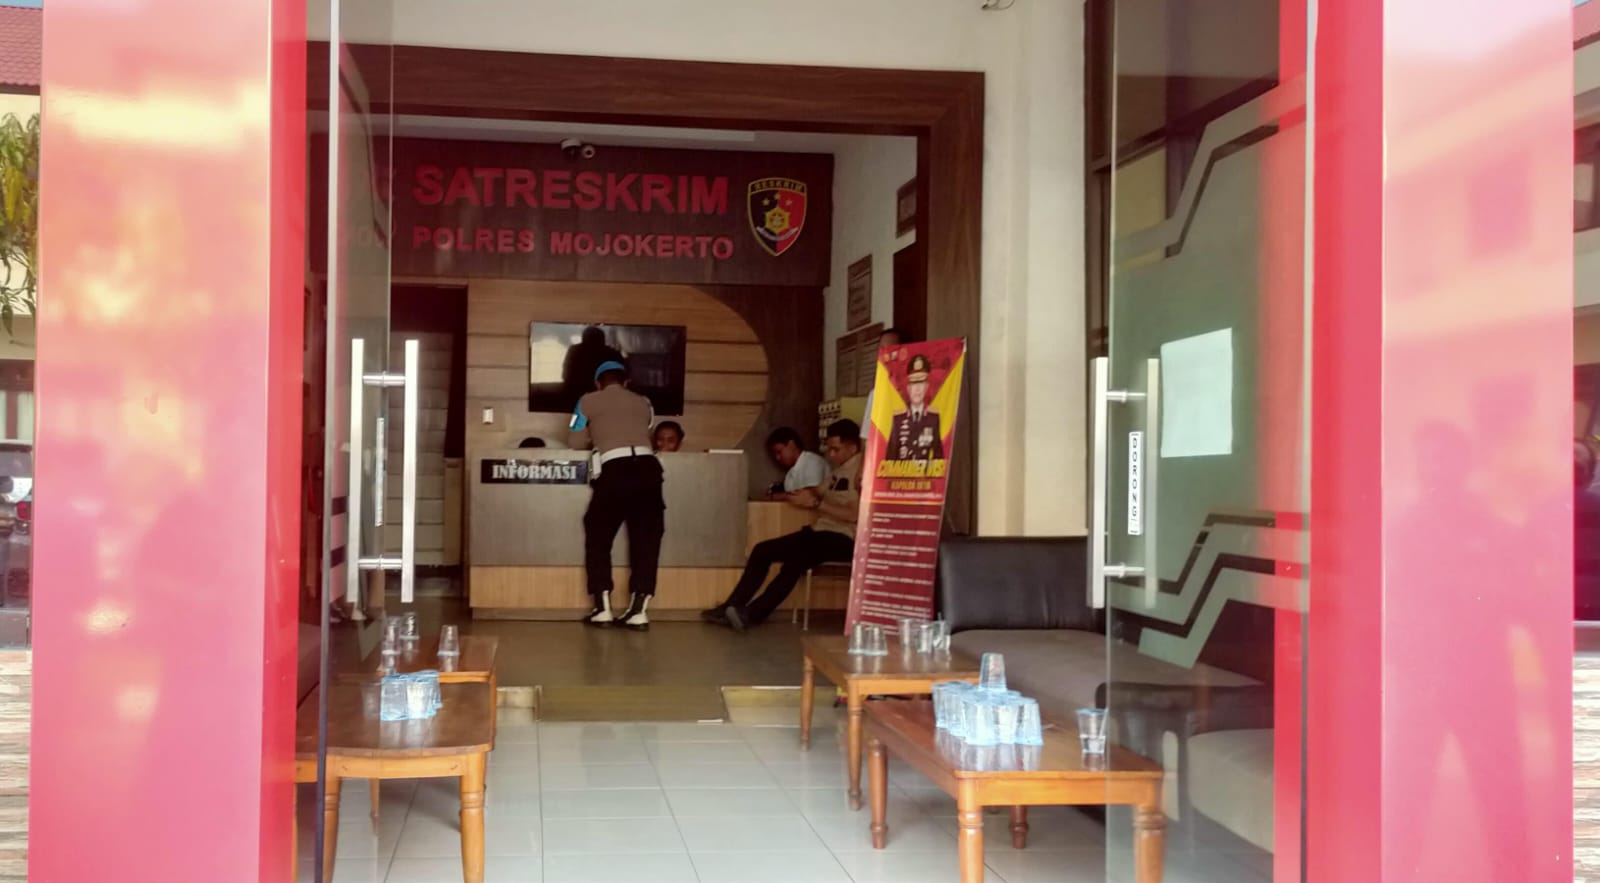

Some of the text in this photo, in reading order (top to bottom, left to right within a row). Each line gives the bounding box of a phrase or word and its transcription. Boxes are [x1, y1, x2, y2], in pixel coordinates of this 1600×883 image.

[413, 163, 729, 215] SATRESKRIM
[411, 225, 535, 254] POLRES
[550, 231, 735, 260] MOJOKERTO
[492, 464, 577, 480] INFORMASI
